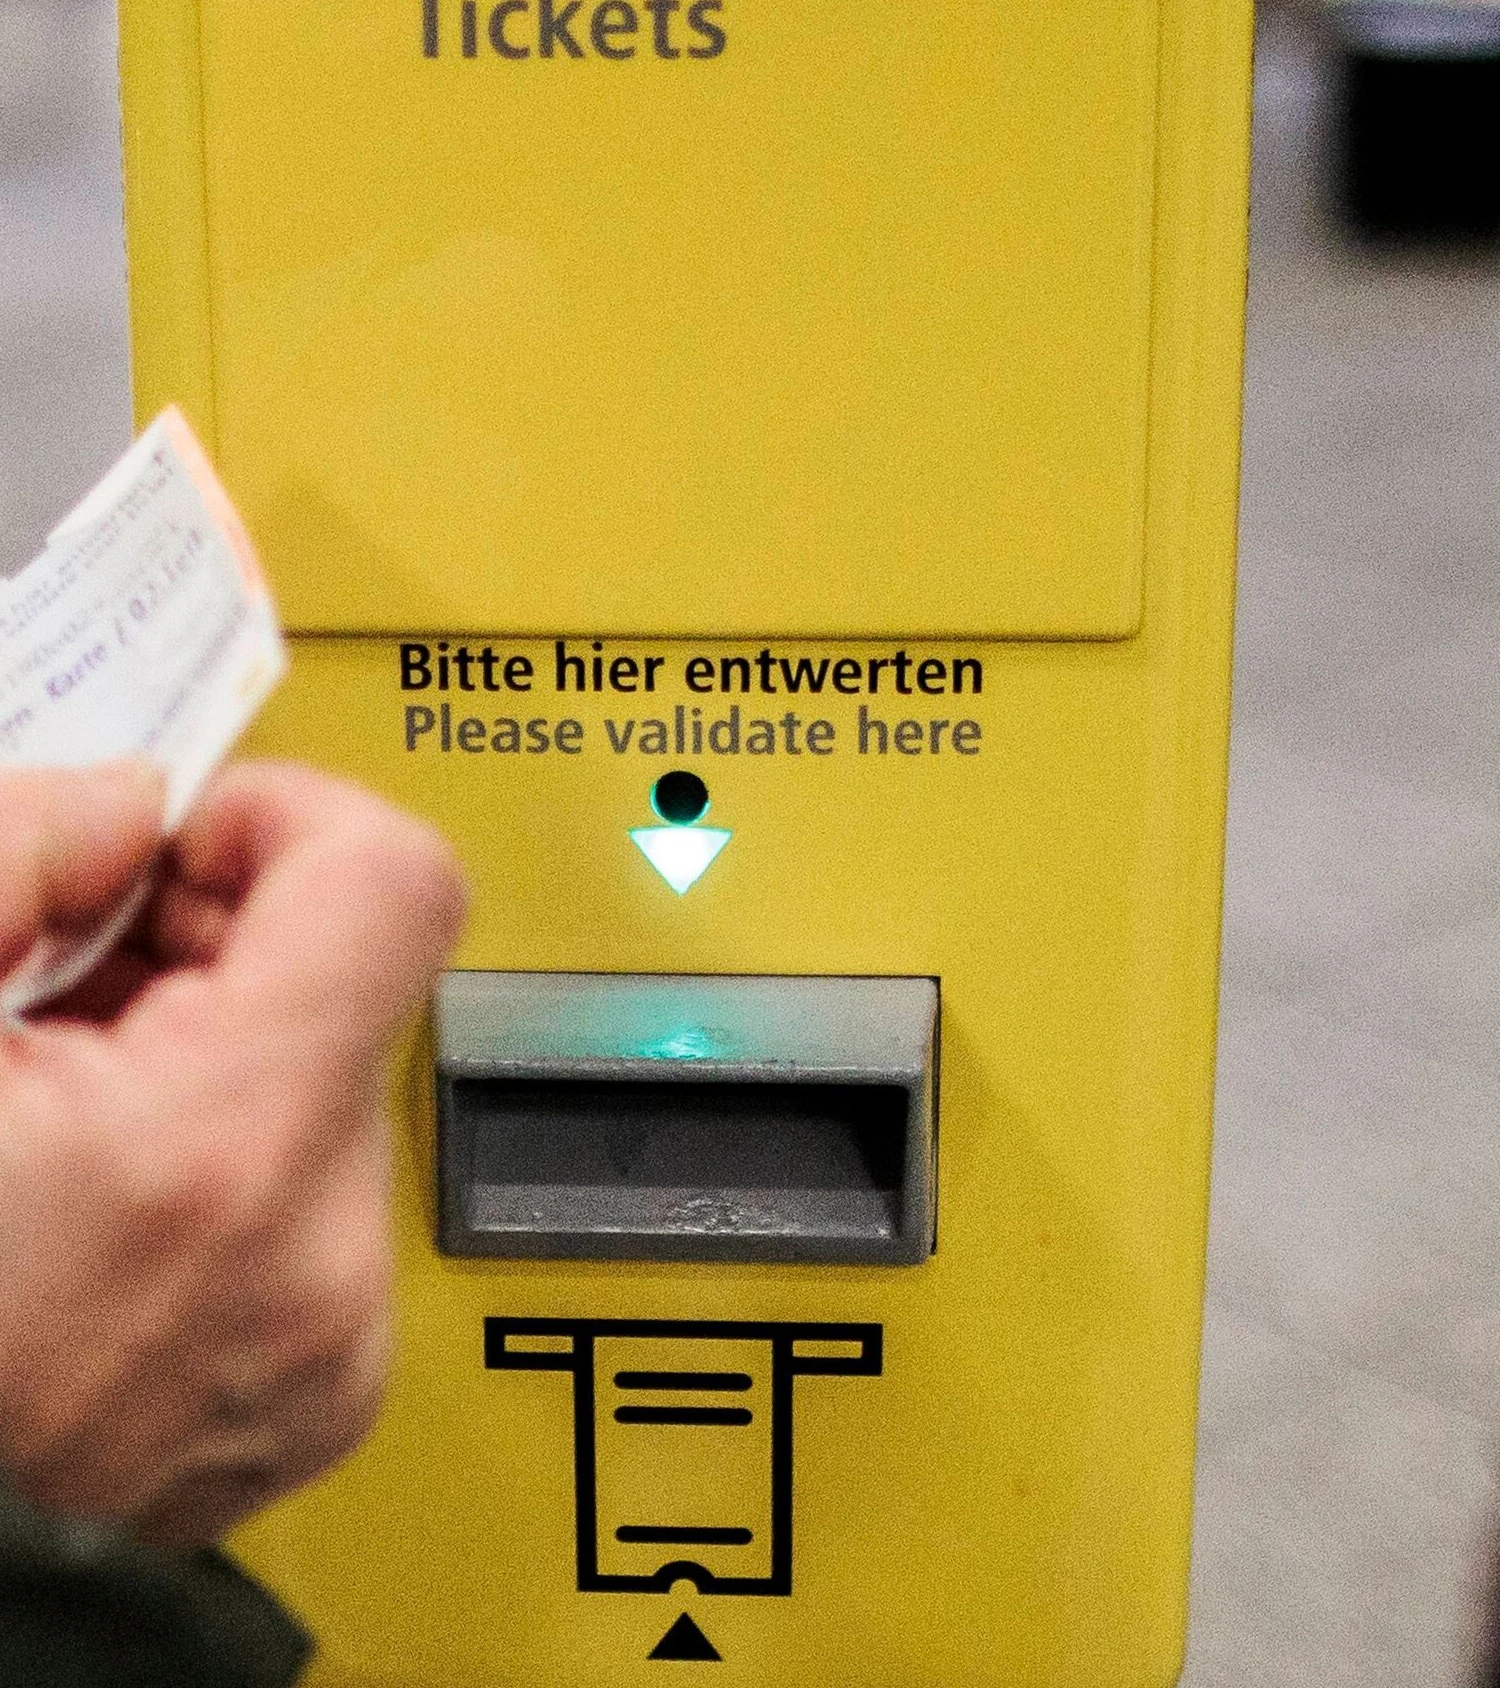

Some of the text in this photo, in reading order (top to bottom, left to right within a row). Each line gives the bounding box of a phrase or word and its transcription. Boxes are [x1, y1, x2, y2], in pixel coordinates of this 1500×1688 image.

[399, 642, 983, 694] Bitte hier entwerten
[404, 704, 982, 756] Please validate here
